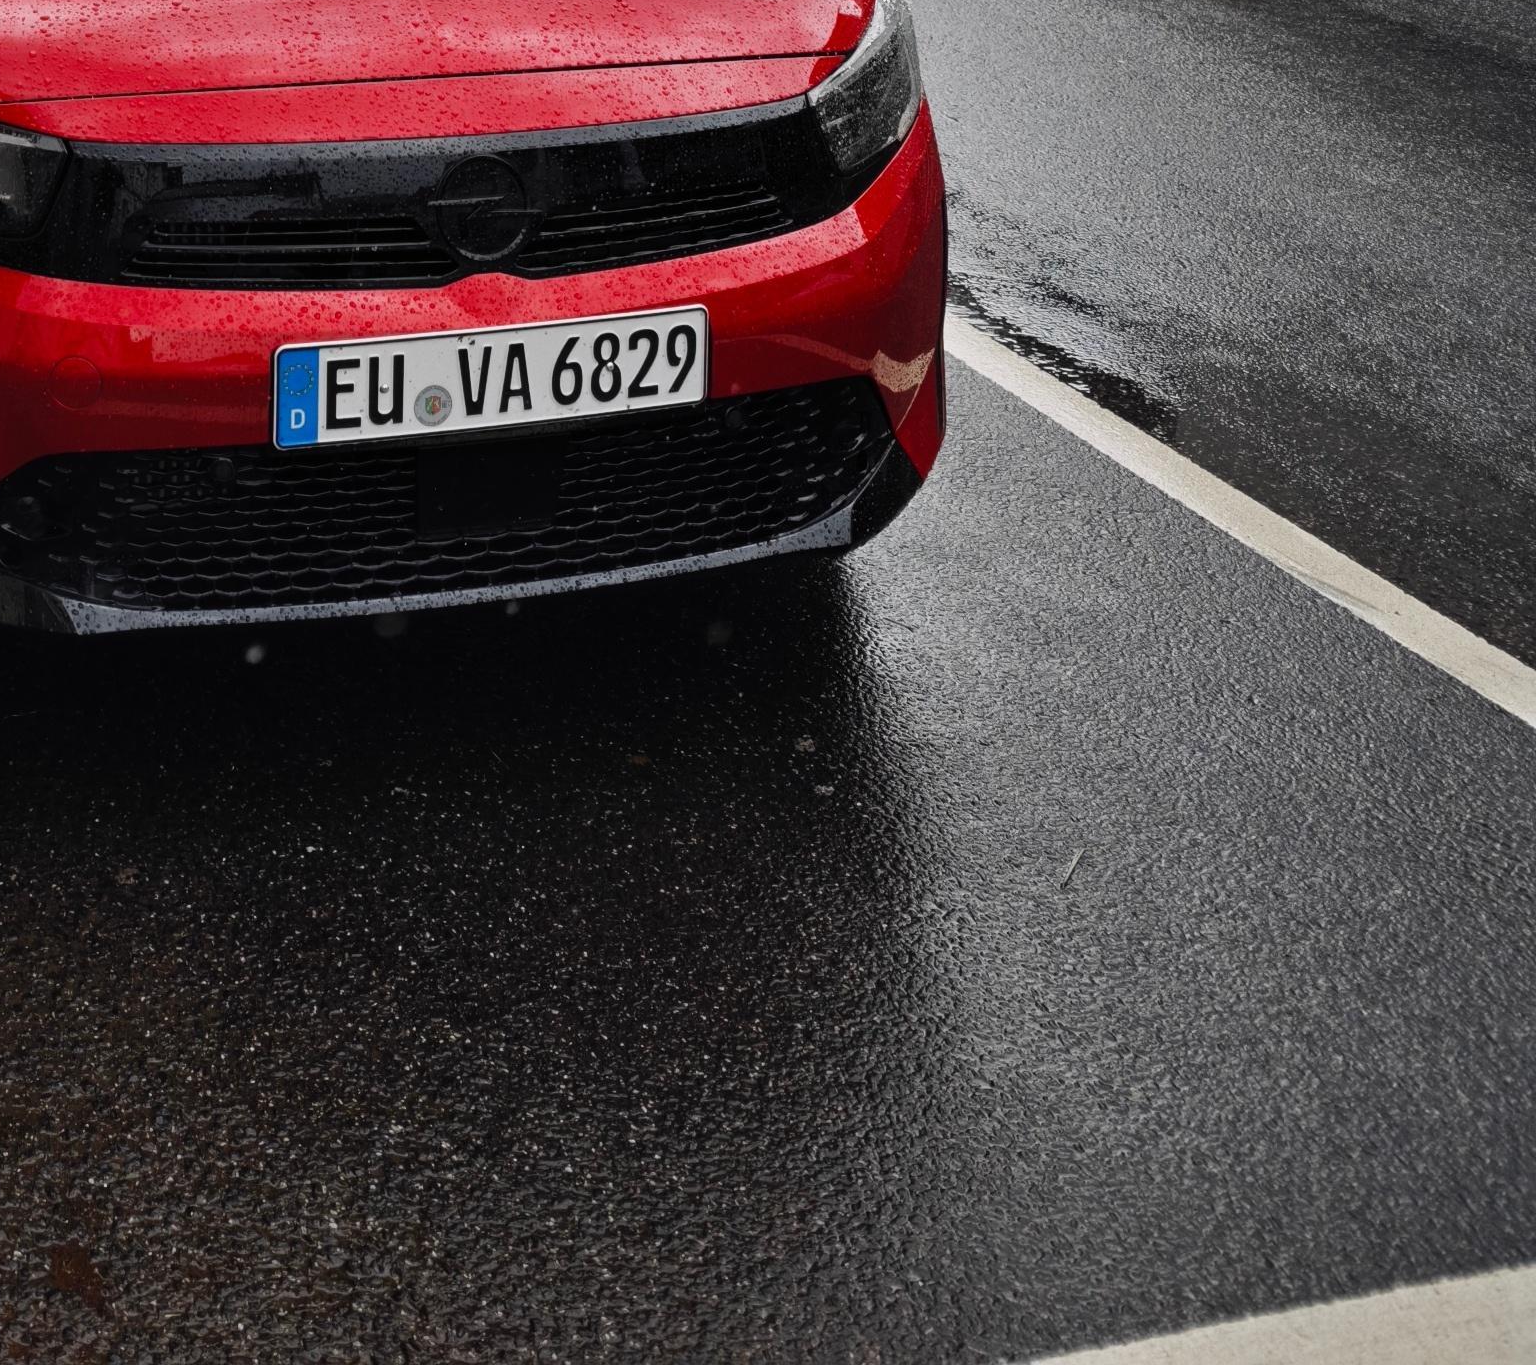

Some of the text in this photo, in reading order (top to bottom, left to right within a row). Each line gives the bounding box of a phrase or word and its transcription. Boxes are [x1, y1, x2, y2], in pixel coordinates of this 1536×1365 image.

[325, 354, 405, 431] EU
[458, 342, 533, 417] VA
[551, 324, 698, 407] 6829
[290, 408, 306, 430] D
